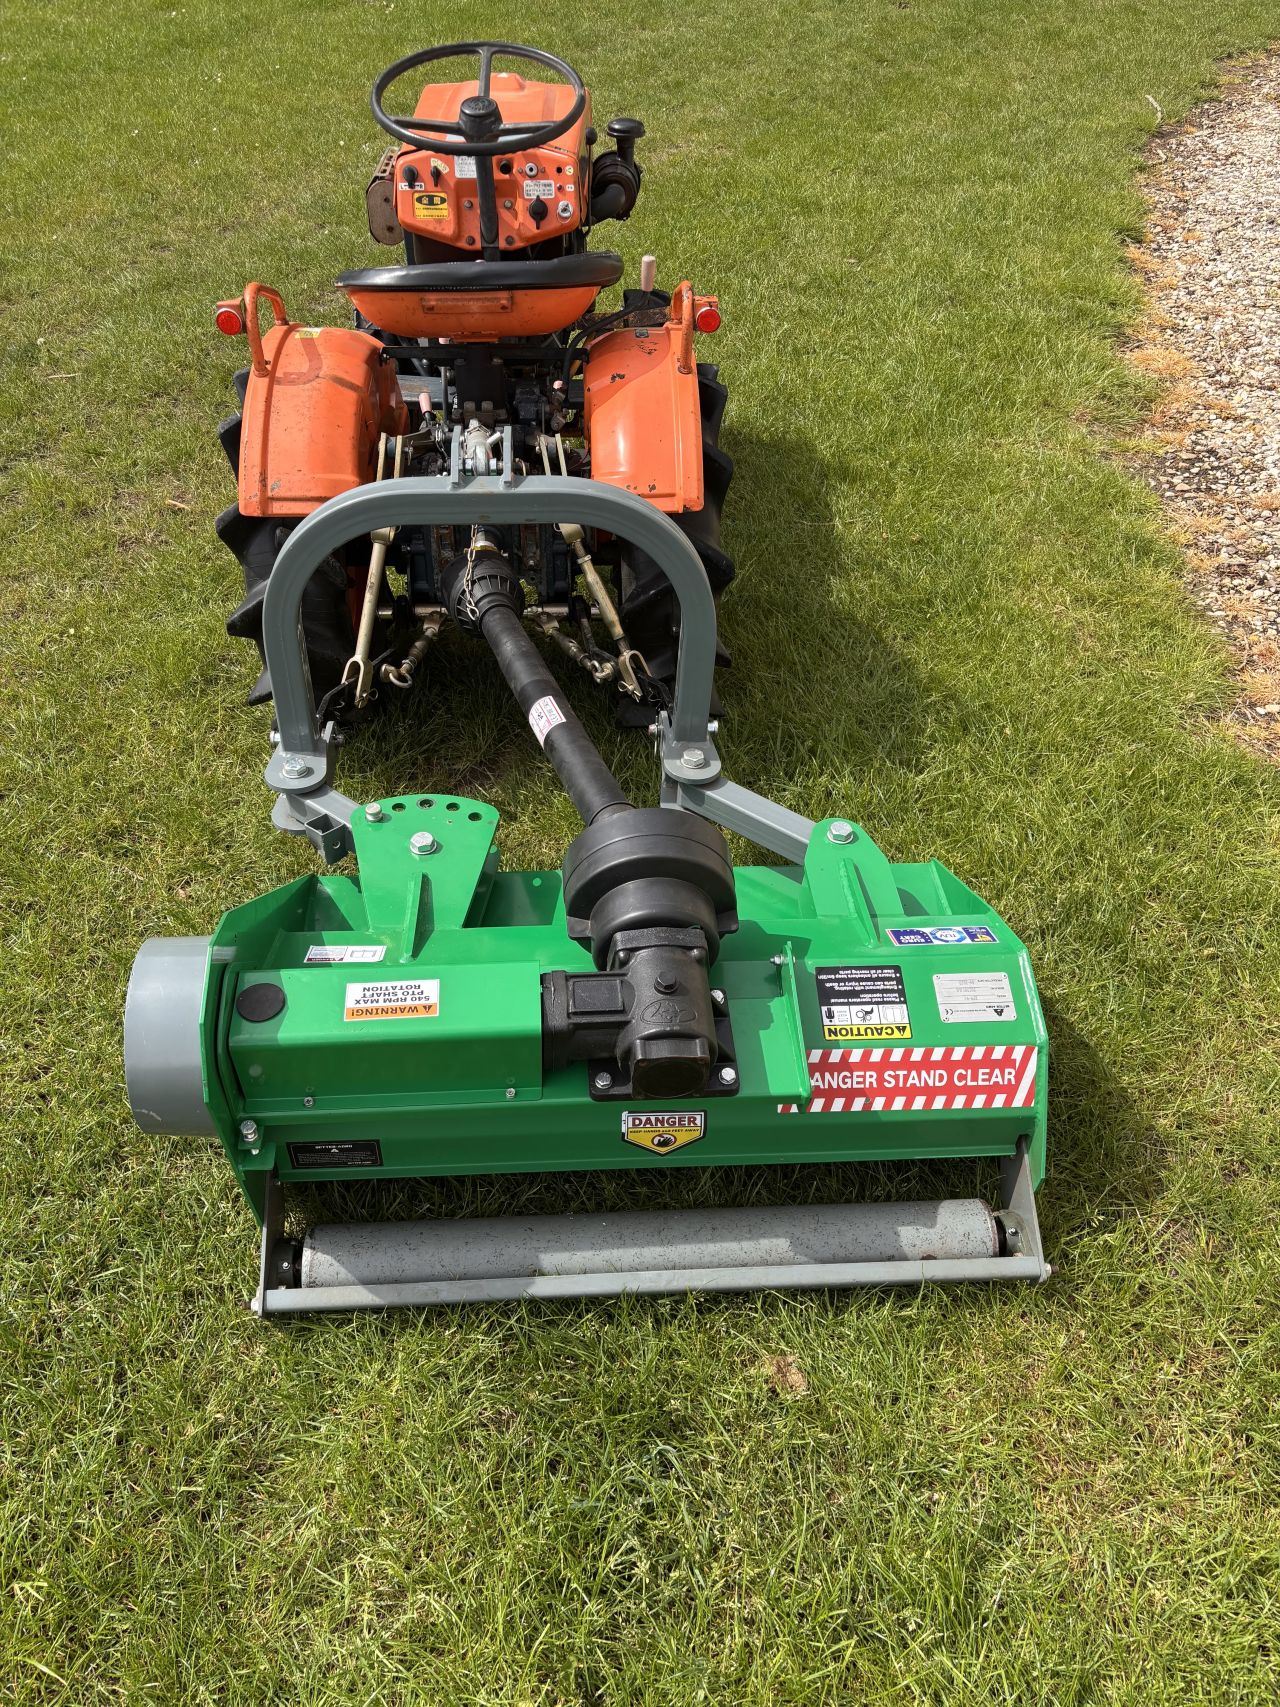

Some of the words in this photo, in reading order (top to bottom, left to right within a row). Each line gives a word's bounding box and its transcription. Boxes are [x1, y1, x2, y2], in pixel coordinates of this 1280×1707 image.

[351, 1006, 418, 1016] WARNING!
[828, 1027, 894, 1037] CAUTION
[810, 1071, 877, 1089] ANGER
[884, 1070, 948, 1088] STAND
[954, 1068, 1016, 1086] CLEAR
[632, 1116, 698, 1126] DANGER
